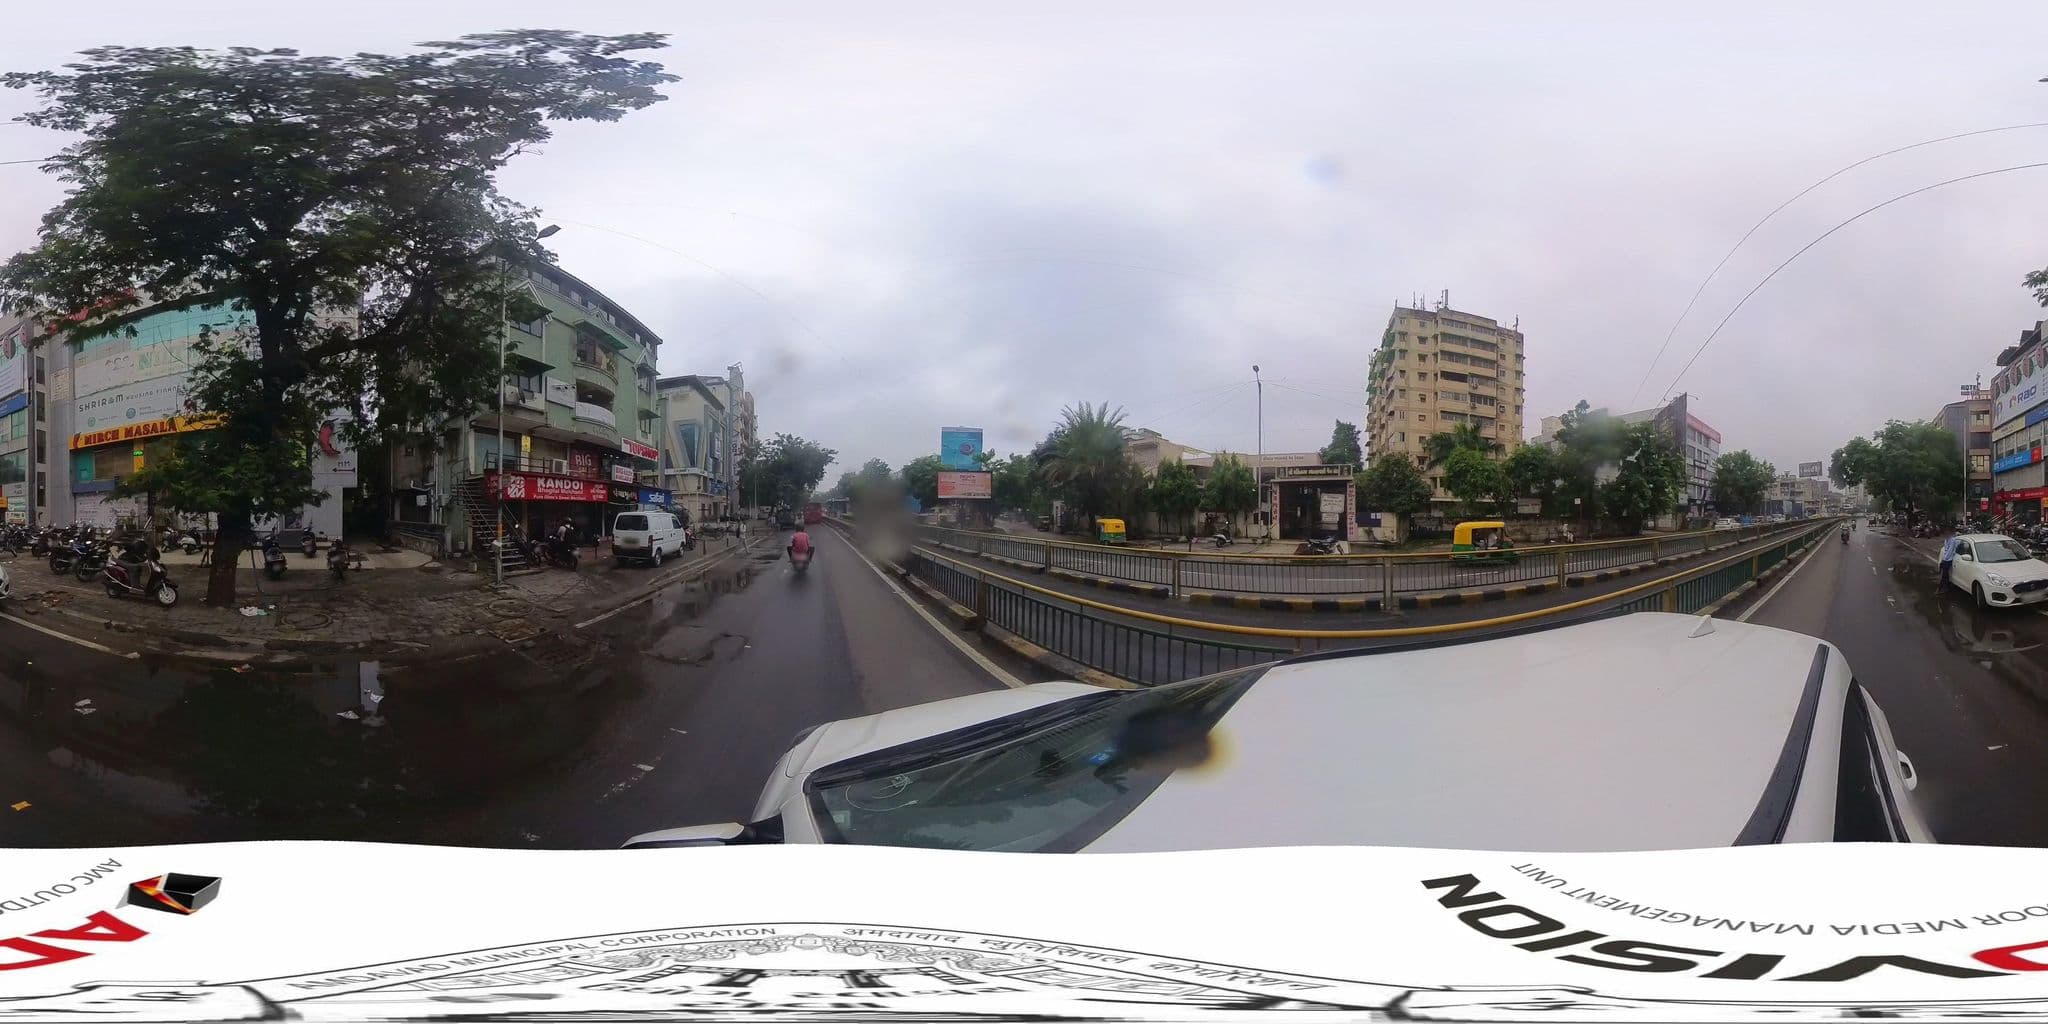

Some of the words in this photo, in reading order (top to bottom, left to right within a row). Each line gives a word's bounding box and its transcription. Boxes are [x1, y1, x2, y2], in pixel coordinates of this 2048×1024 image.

[84, 429, 119, 445] MIRCH
[125, 420, 178, 438] MASALA
[575, 454, 592, 466] BIG
[537, 477, 584, 490] KANDOI
